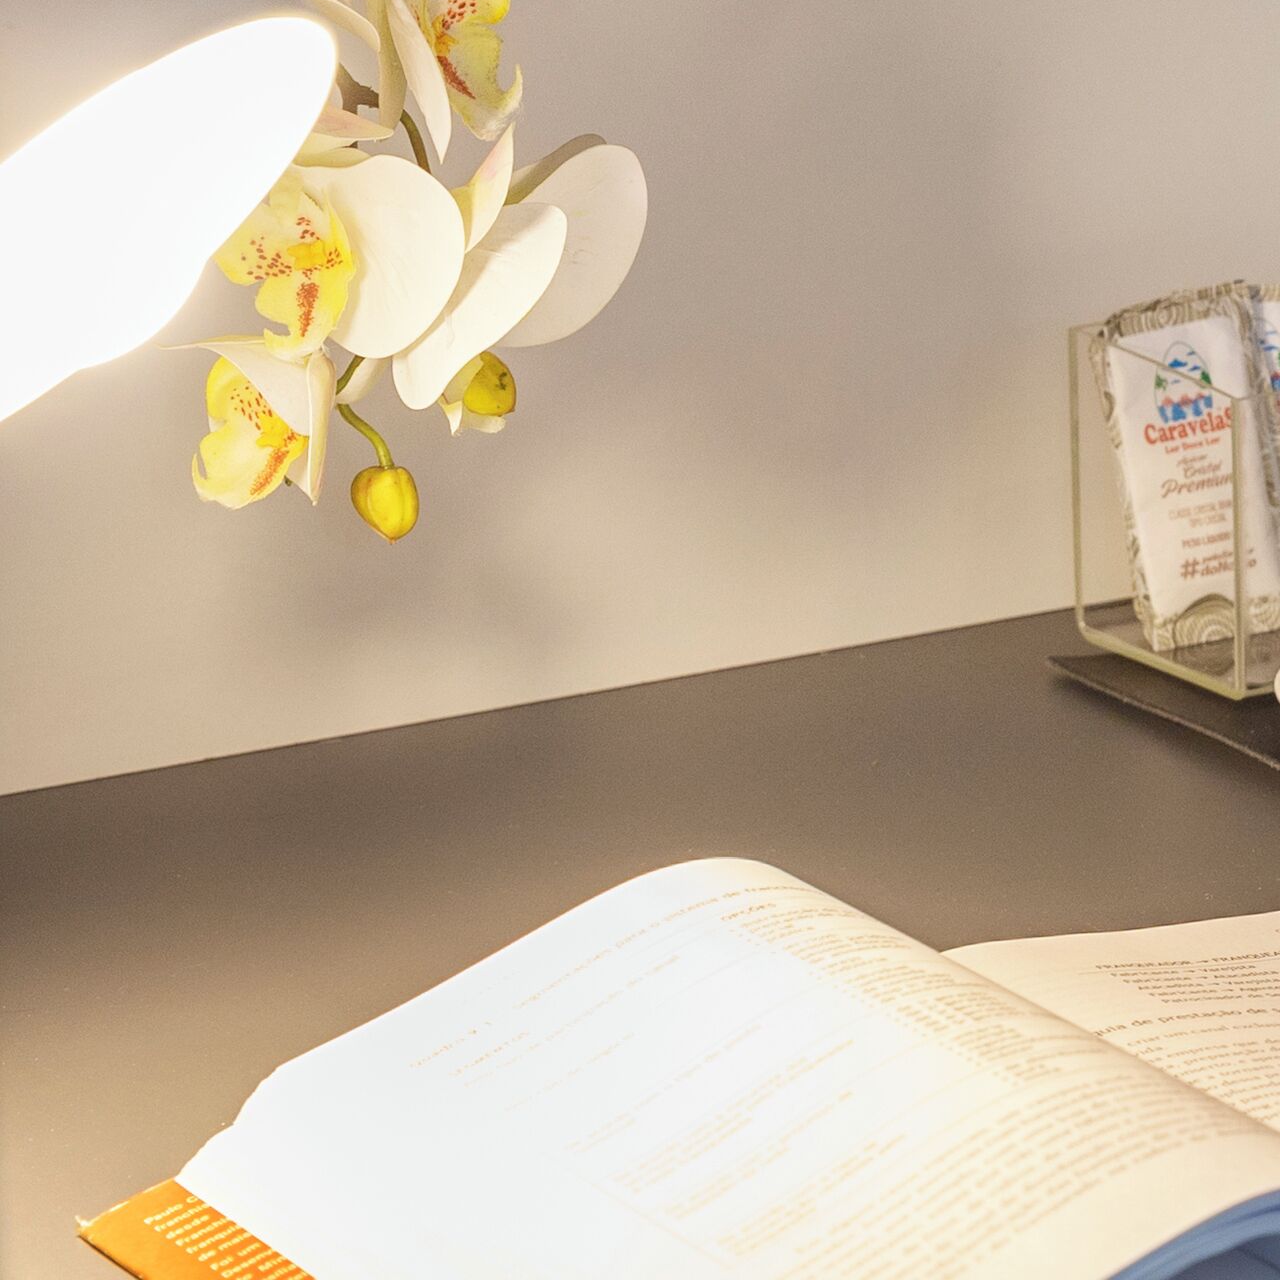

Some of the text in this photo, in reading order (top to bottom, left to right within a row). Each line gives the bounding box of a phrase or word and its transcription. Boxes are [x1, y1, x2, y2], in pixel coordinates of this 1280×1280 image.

[1096, 960, 1191, 970] FRANQUEADOR
[1130, 1017, 1151, 1027] de
[1158, 1008, 1242, 1025] prestação
[1246, 1006, 1265, 1014] de
